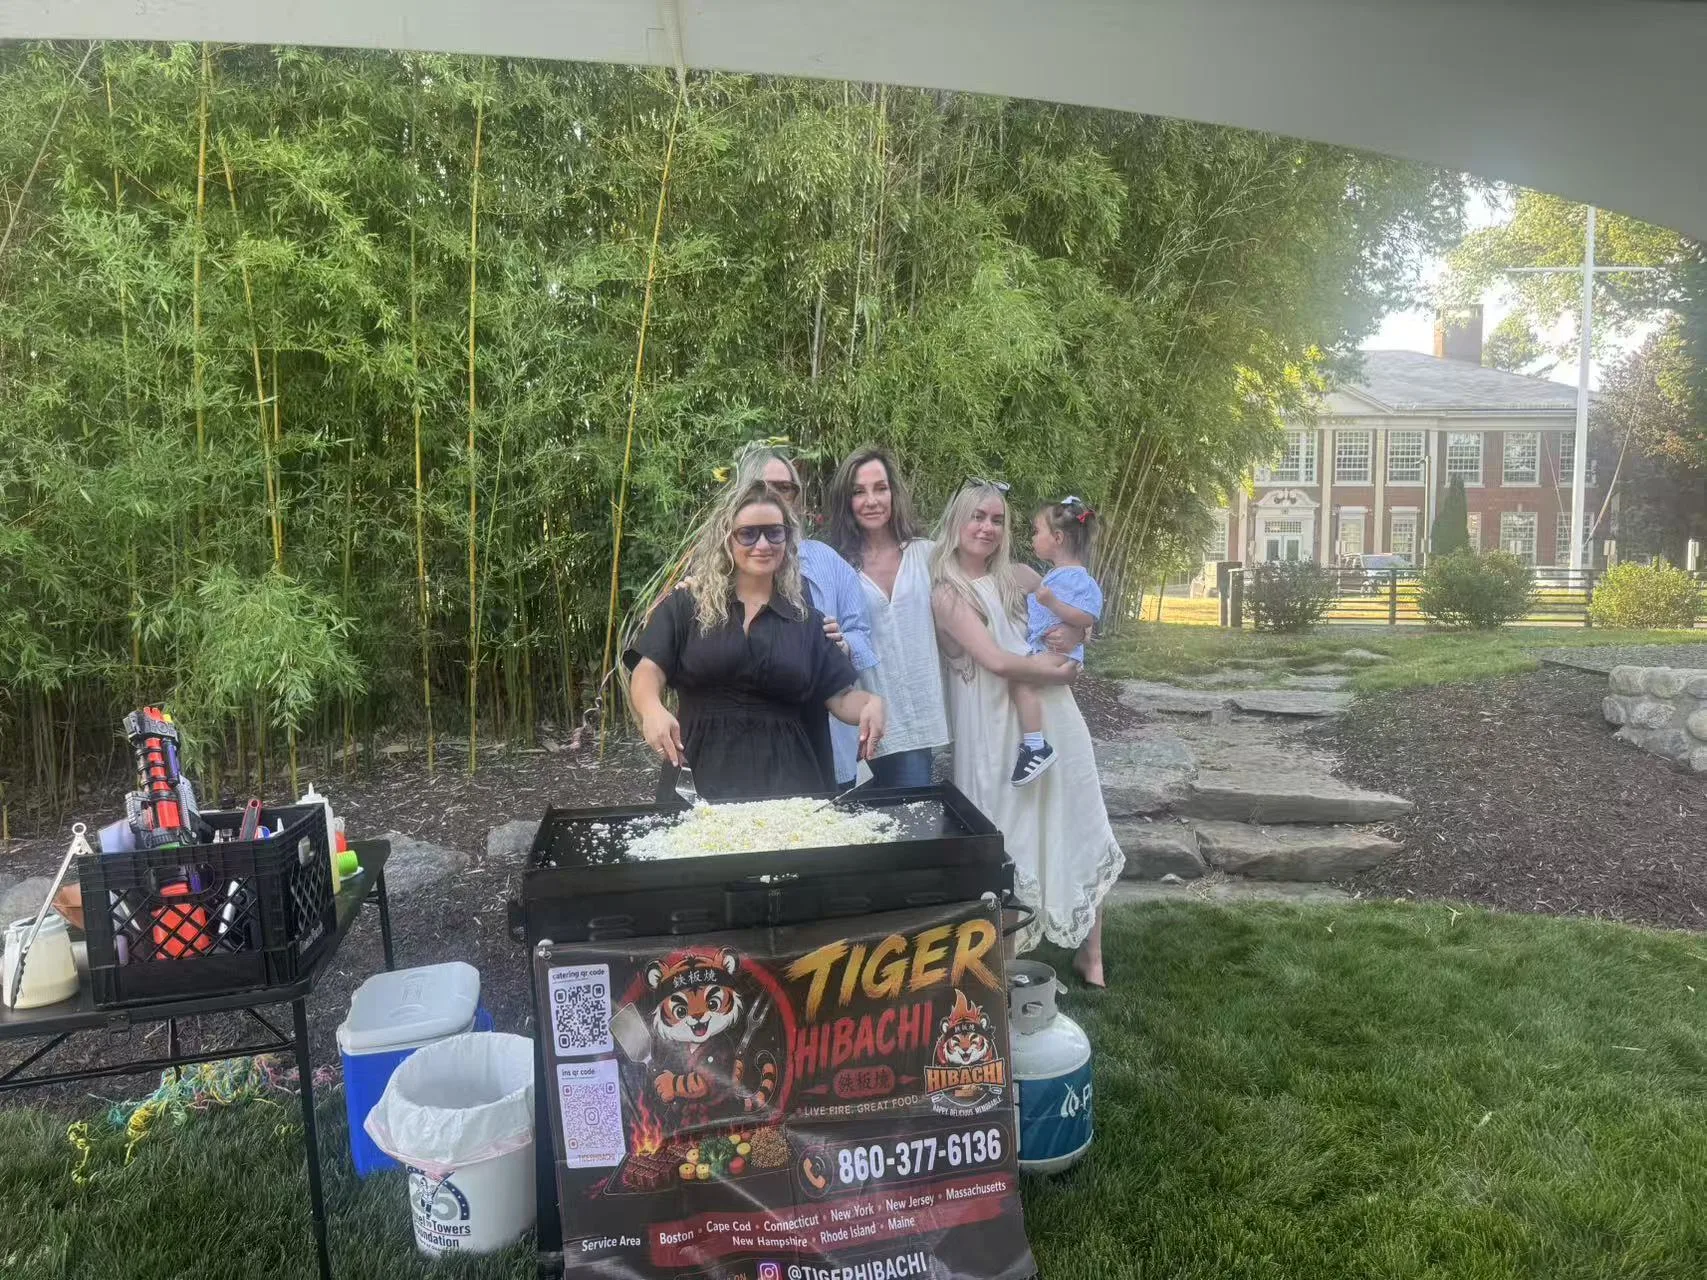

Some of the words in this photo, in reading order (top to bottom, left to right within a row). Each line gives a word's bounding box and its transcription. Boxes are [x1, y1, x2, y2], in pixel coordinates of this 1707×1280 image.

[552, 970, 579, 980] catering
[784, 919, 1003, 1023] TIGER
[794, 1000, 933, 1078] HIBACHI
[581, 1068, 595, 1076] code
[926, 1060, 1004, 1094] HIBACHI
[804, 1106, 825, 1116] LIVE
[856, 1101, 889, 1113] GREAT
[838, 1128, 1002, 1184] 860-377-6136
[431, 1220, 471, 1234] Towers
[659, 1229, 694, 1245] Boston
[706, 1220, 730, 1233] Cape
[733, 1220, 751, 1232] Cod
[763, 1214, 819, 1232] Connecticut
[830, 1210, 851, 1222] New
[853, 1203, 874, 1218] York
[885, 1199, 906, 1213] New
[908, 1194, 935, 1208] Jersey
[945, 1180, 1006, 1201] Massachusetts
[581, 1237, 617, 1252] Service
[619, 1235, 641, 1247] Area
[732, 1235, 754, 1246] New
[757, 1235, 808, 1248] Hampshire
[820, 1229, 848, 1244] Rhode
[850, 1222, 876, 1238] Island
[887, 1216, 915, 1231] Maine
